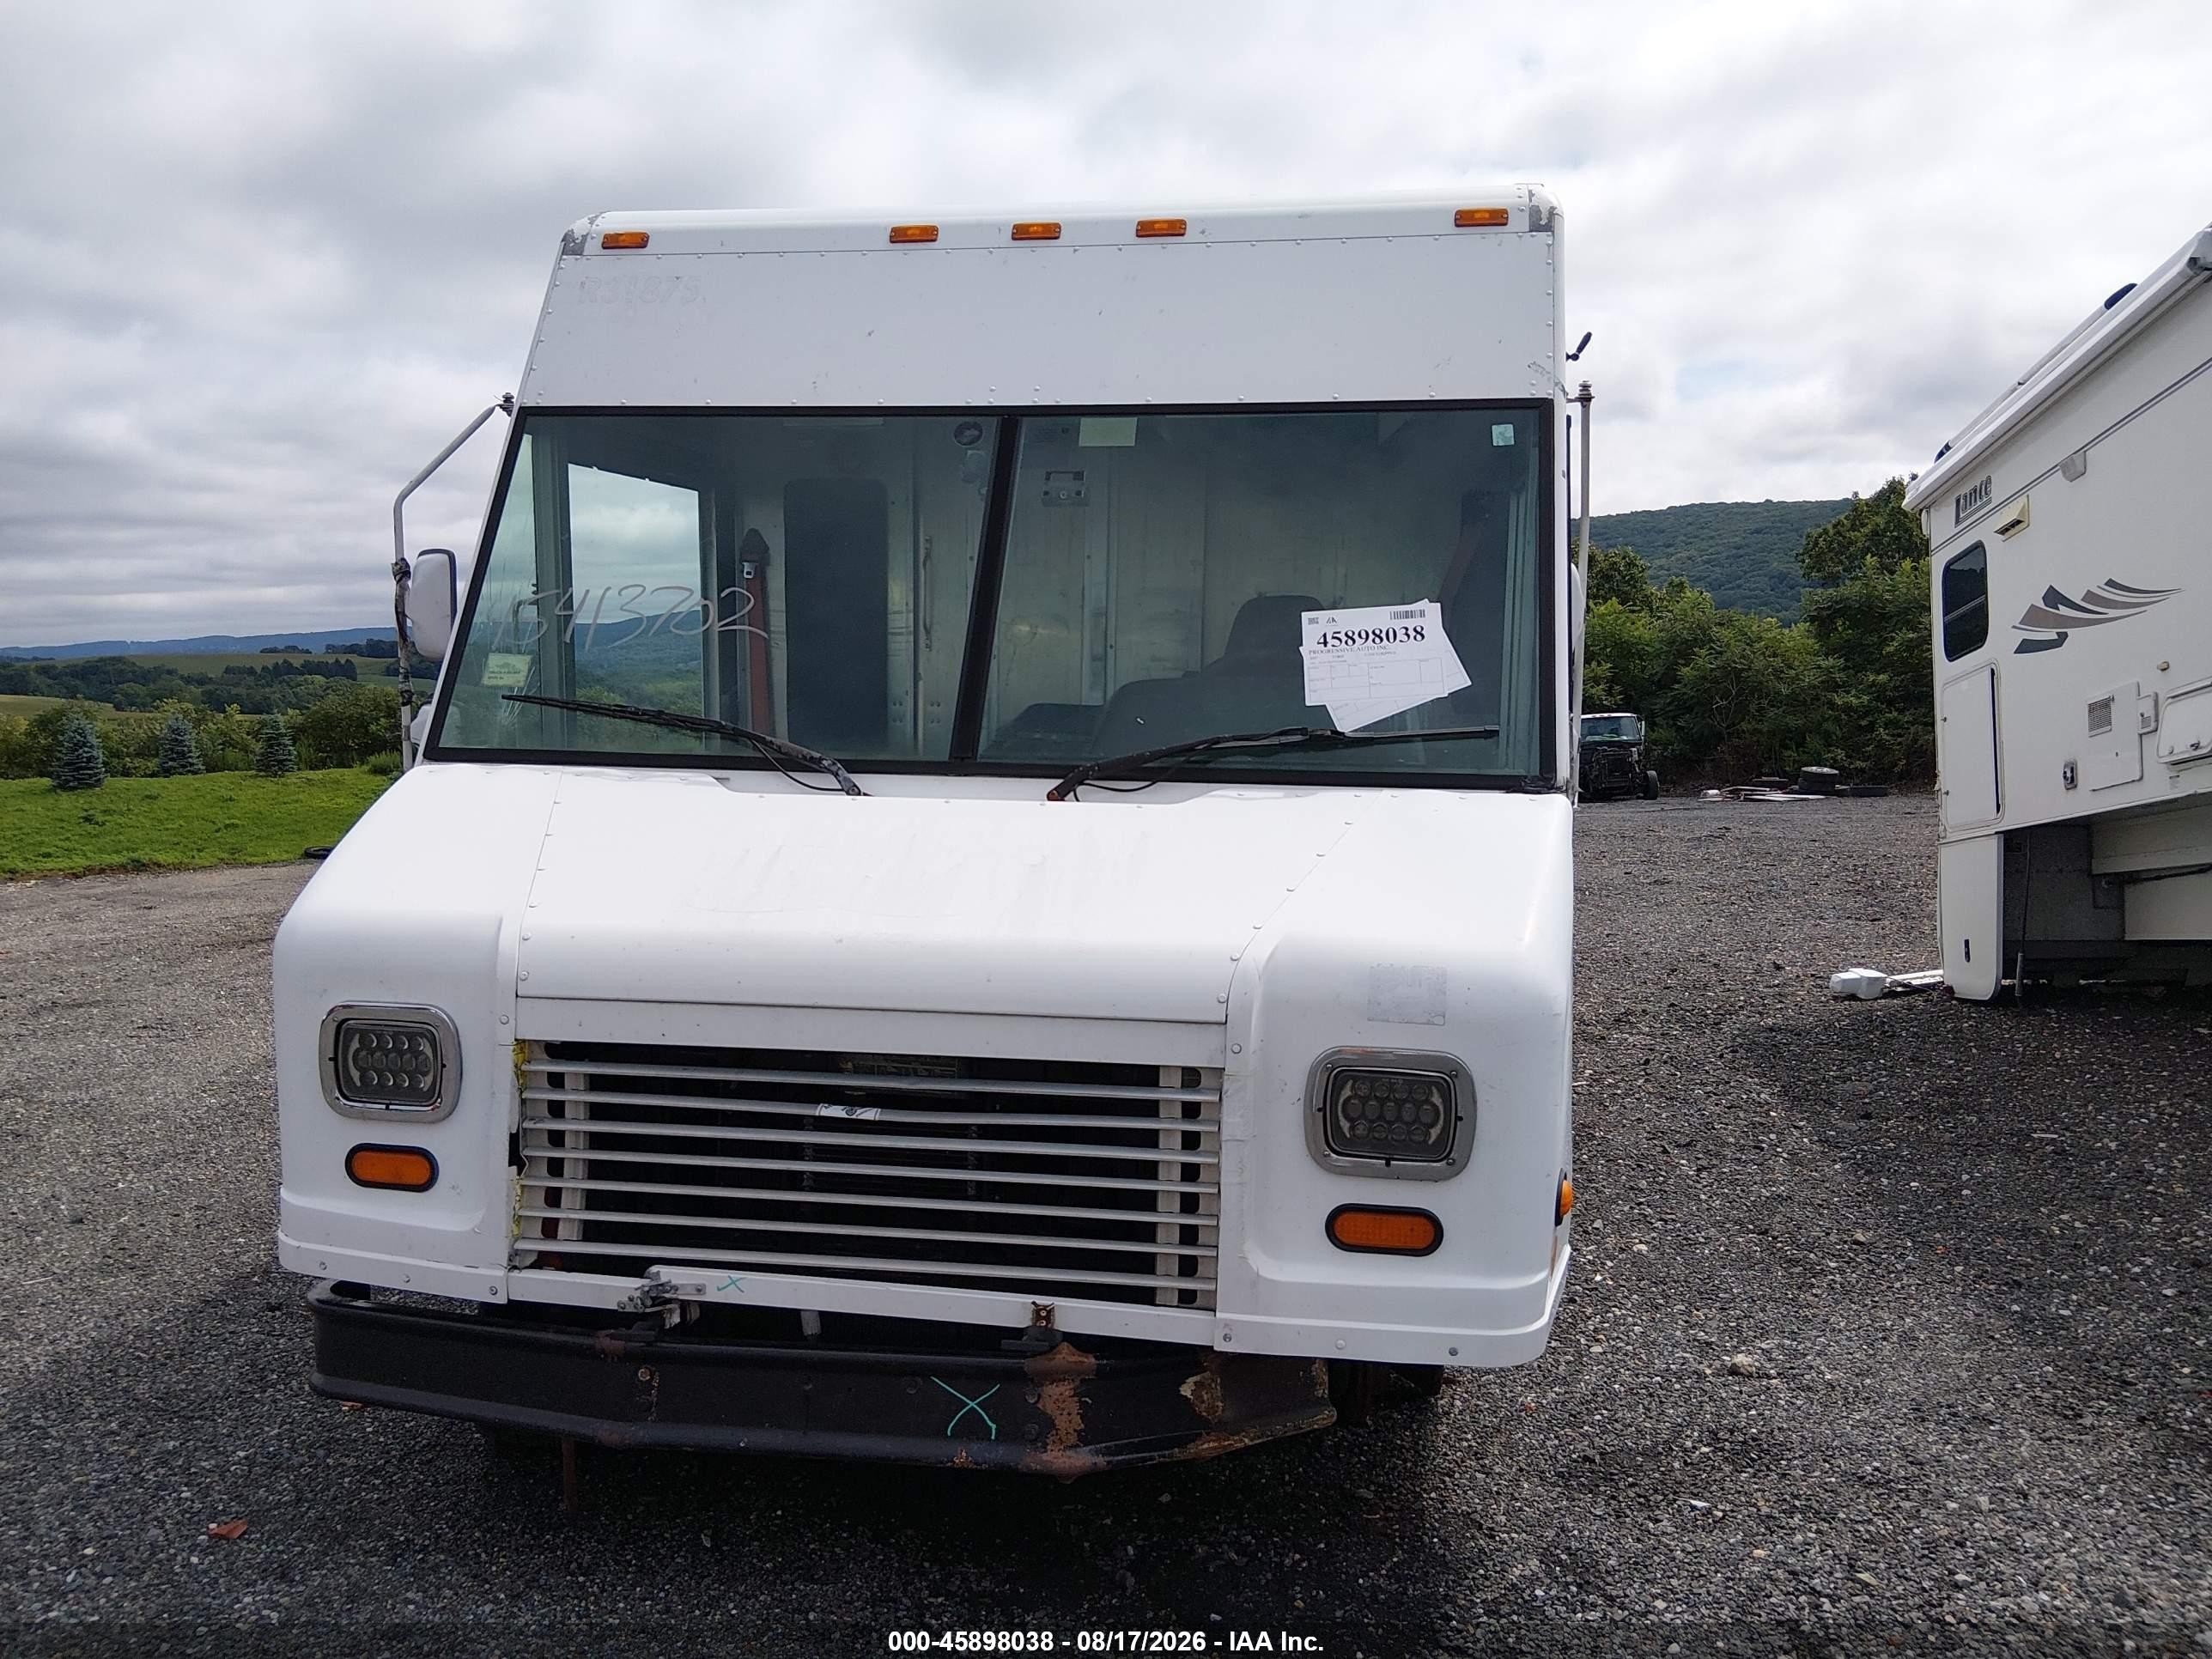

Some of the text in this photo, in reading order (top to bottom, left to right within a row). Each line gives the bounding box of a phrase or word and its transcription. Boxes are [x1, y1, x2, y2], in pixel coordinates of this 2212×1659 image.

[1954, 476, 1991, 528] Lance
[1316, 625, 1425, 648] 45898038
[1309, 647, 1355, 655] PROGRESSIVE
